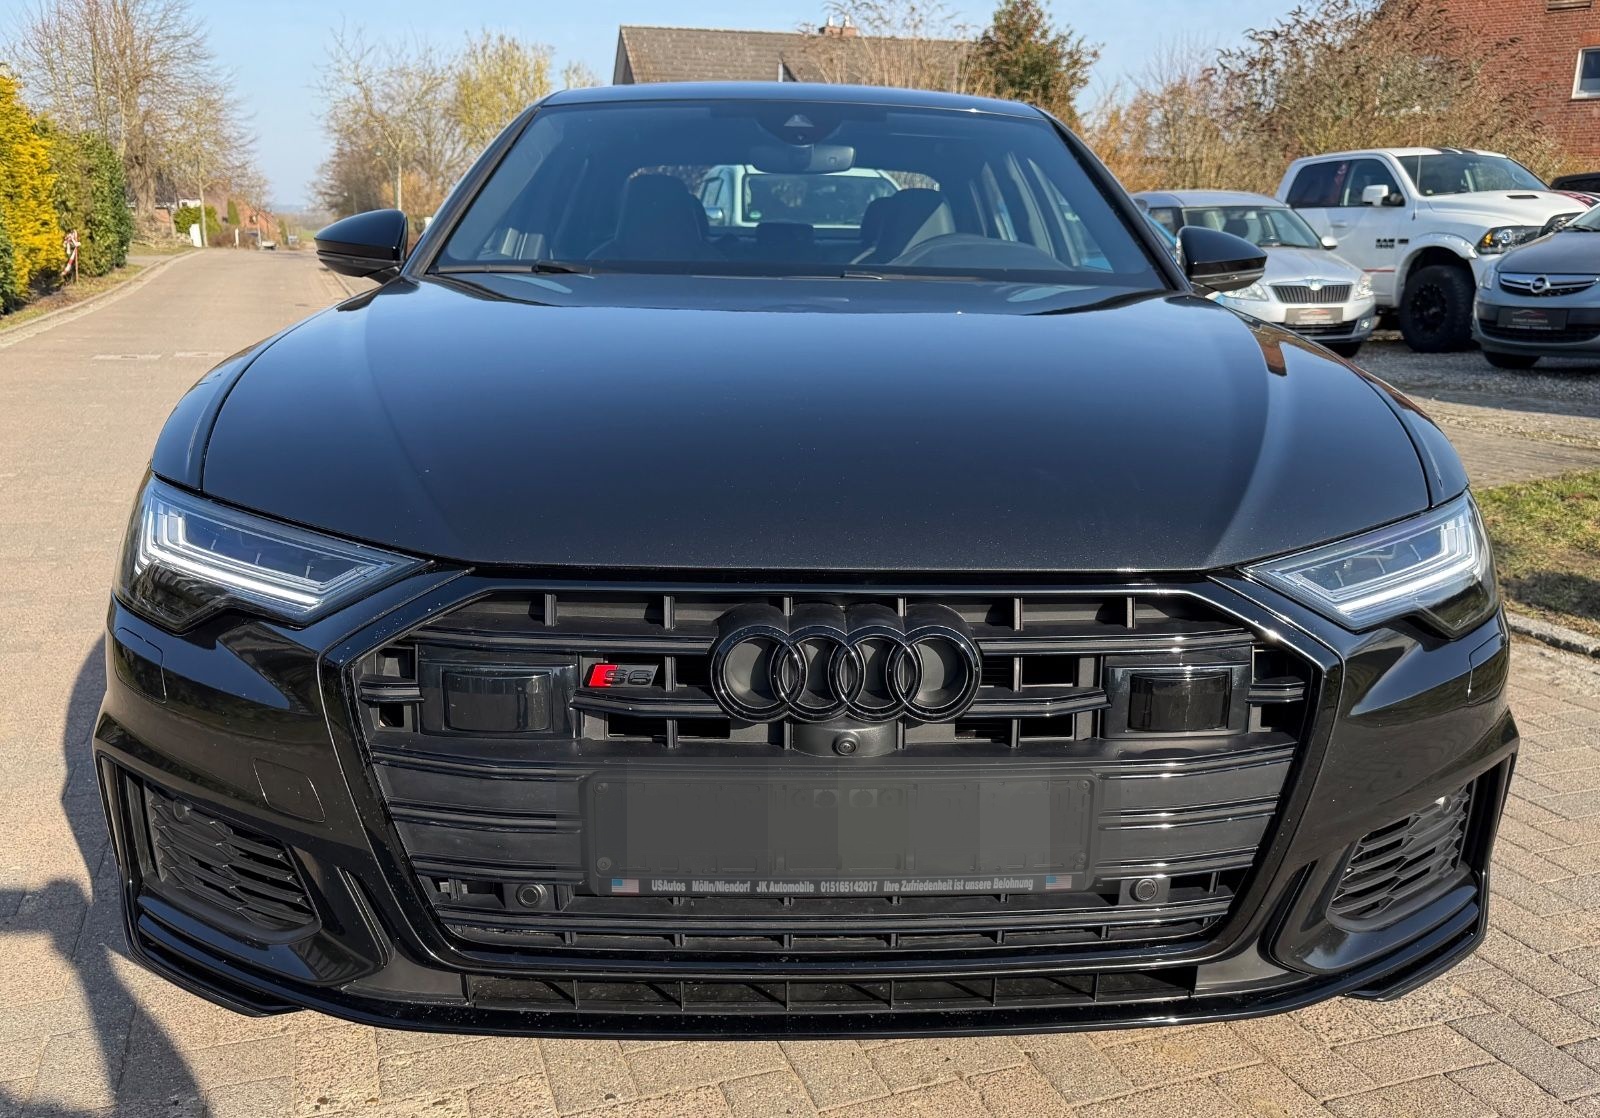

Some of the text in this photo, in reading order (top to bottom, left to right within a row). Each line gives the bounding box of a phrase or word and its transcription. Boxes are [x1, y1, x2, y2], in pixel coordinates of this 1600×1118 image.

[602, 668, 655, 686] S6
[651, 877, 1033, 893] USAutos Mölln/Niendorf JK Automobile 015165142017 Ihre Zufriedenheit ist unsere Belohnung
